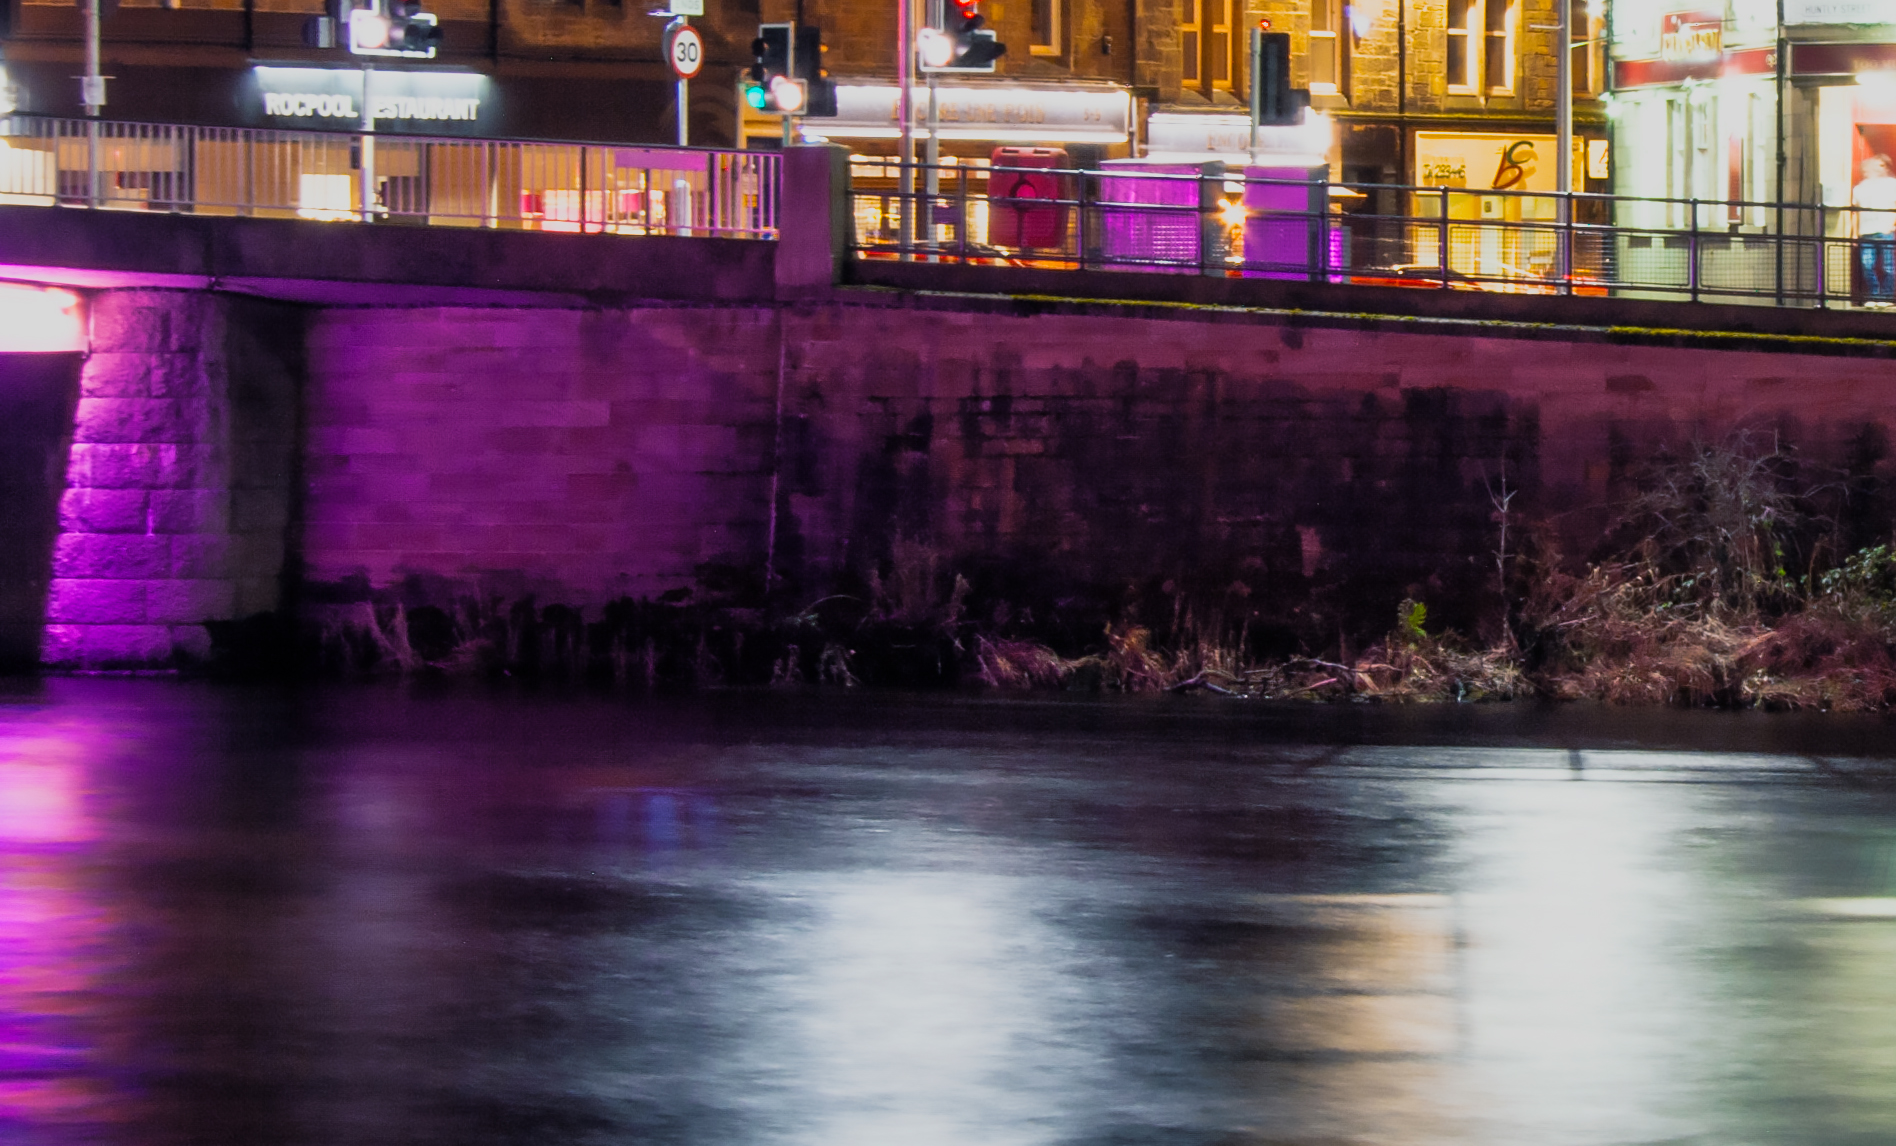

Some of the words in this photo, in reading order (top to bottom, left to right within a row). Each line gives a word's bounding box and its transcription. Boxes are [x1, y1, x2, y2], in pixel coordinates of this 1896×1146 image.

[676, 42, 698, 63] 30
[264, 92, 358, 118] ROCPOOL
[371, 96, 481, 121] ESTAURANT
